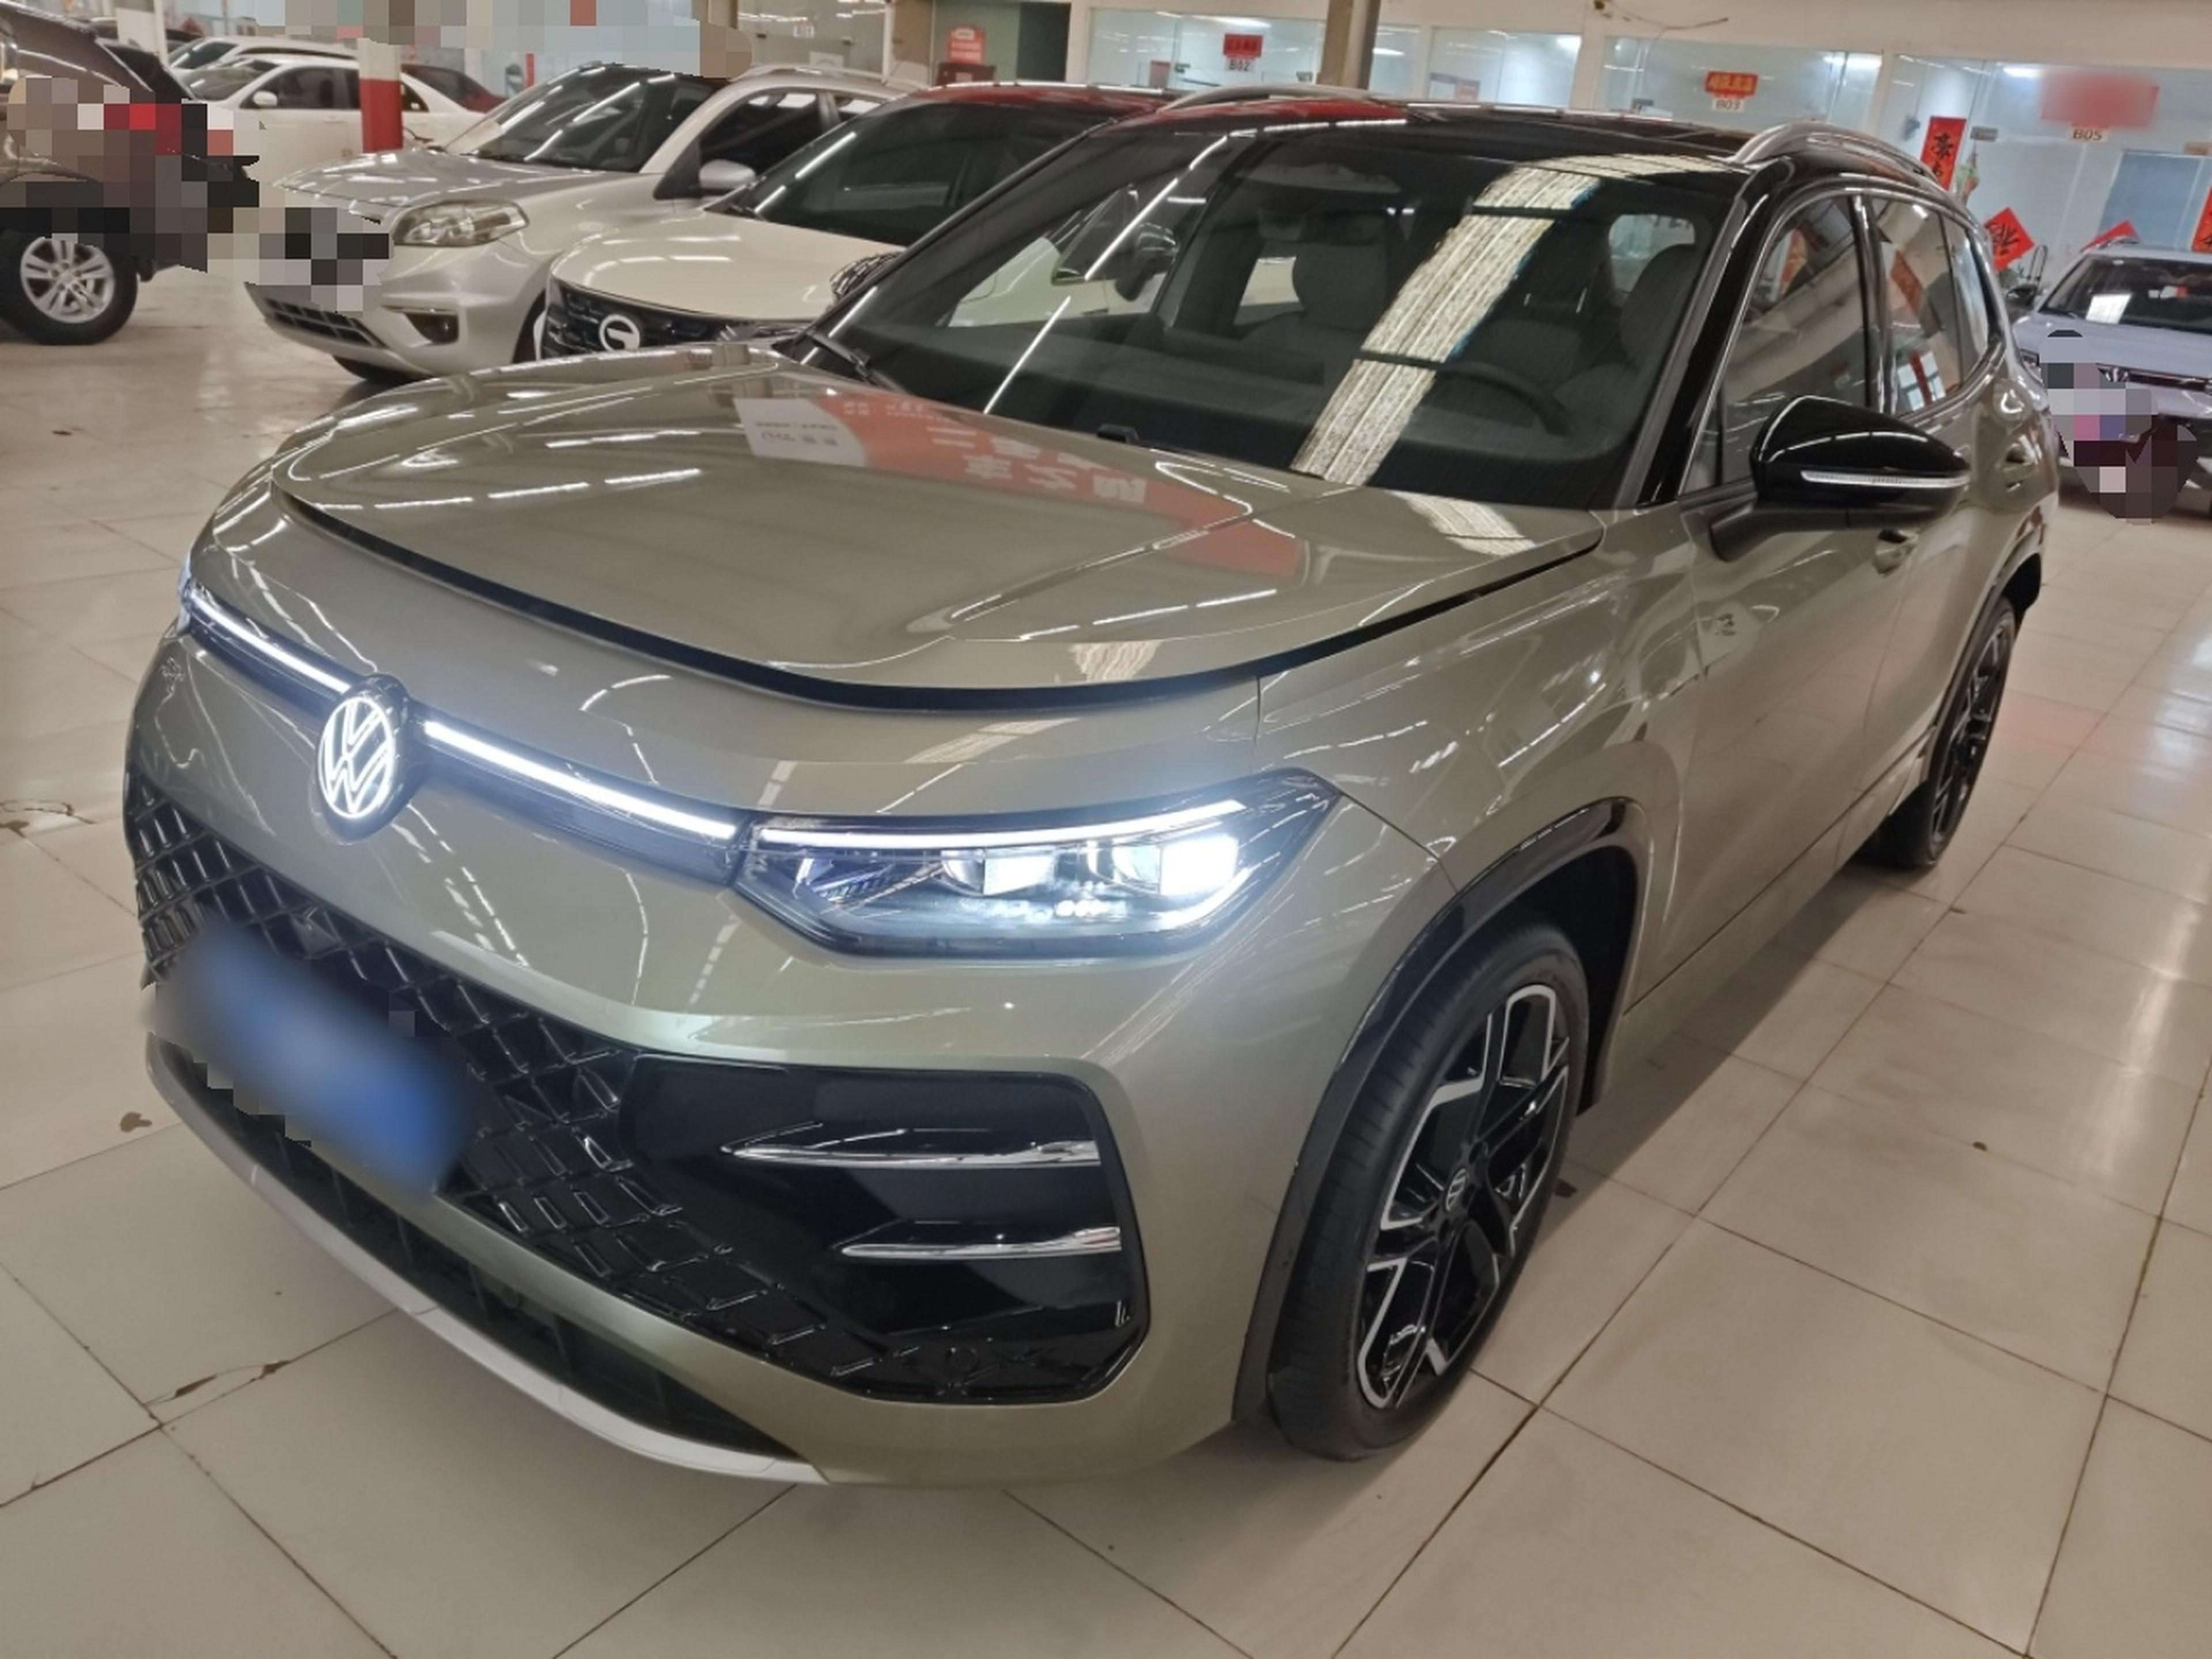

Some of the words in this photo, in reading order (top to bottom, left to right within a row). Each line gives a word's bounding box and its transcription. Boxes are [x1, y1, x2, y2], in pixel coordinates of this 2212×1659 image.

[1715, 99, 1741, 110] B03
[2073, 128, 2103, 141] B05
[320, 696, 396, 819] VW
